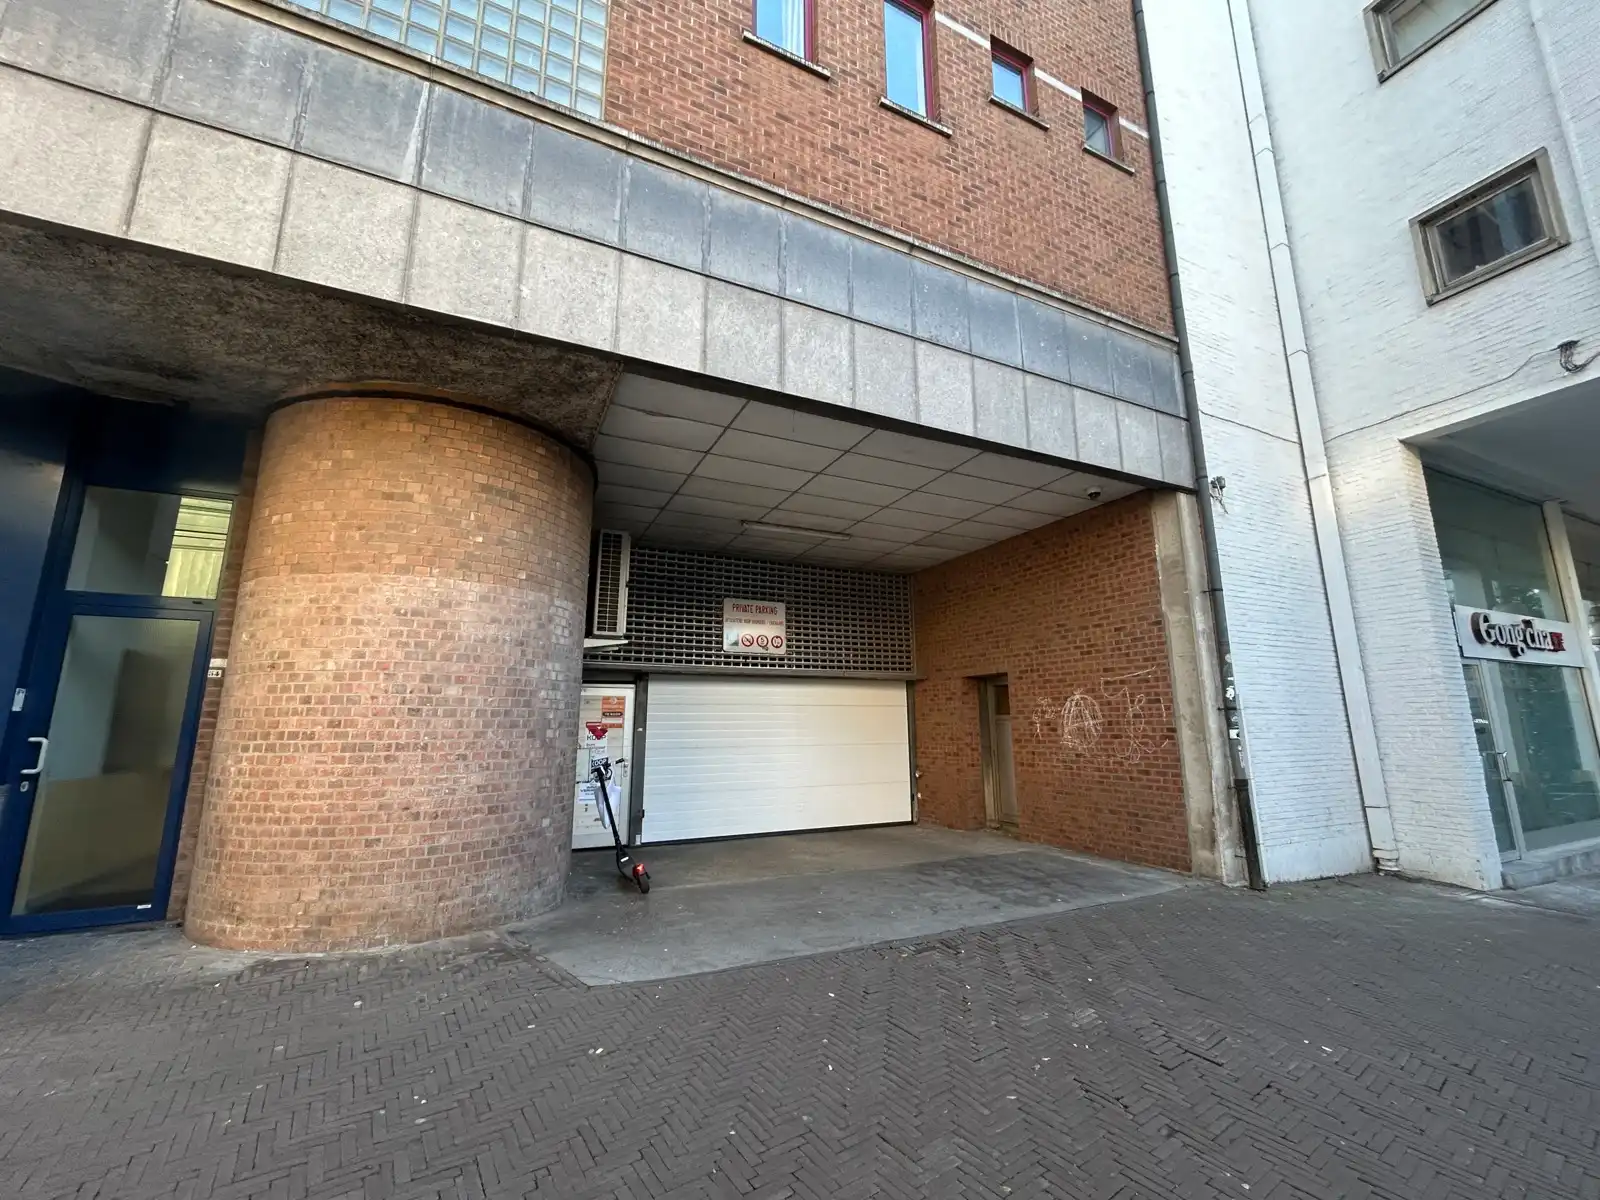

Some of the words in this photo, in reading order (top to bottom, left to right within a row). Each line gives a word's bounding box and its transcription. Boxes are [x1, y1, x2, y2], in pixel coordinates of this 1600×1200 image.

[732, 603, 753, 614] PRIVATE
[755, 604, 778, 616] PARKING
[1471, 612, 1527, 658] Gong
